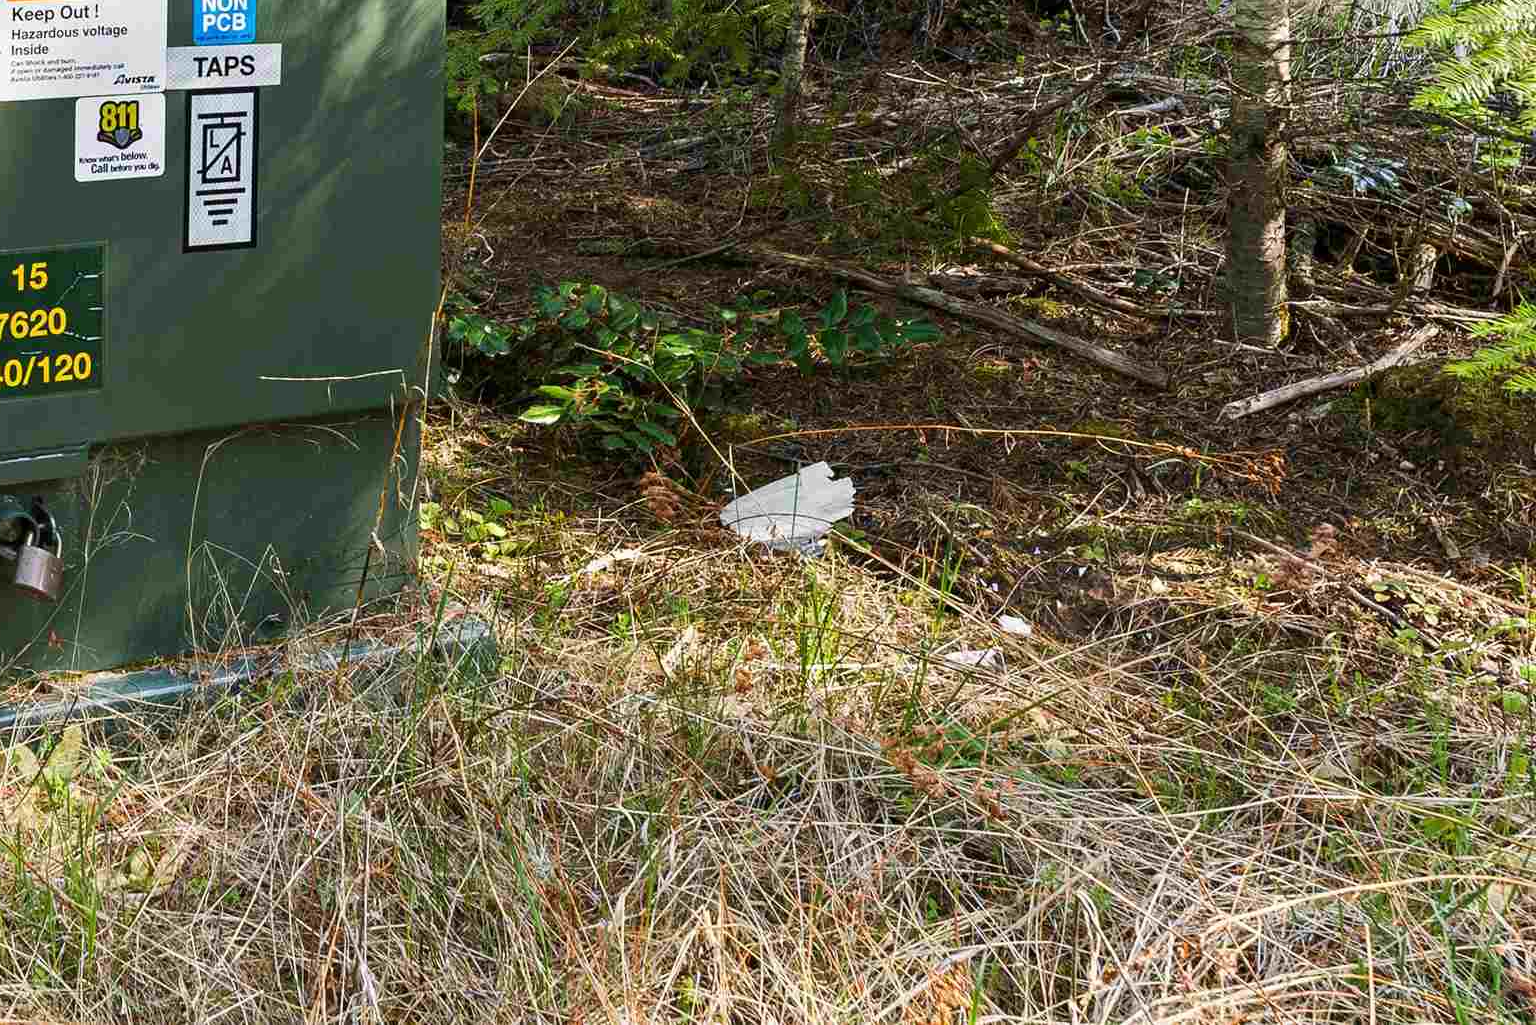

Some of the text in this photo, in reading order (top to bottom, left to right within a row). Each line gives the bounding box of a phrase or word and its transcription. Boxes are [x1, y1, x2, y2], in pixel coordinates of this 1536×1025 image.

[12, 7, 55, 23] Keep
[60, 5, 89, 20] Out
[202, 12, 247, 32] PCB
[11, 25, 128, 40] Hazardous voltage
[11, 44, 49, 56] Inside
[193, 55, 255, 77] TAPS
[99, 101, 139, 132] 811
[210, 130, 220, 147] L
[91, 163, 109, 173] Call
[221, 156, 233, 174] A
[11, 262, 49, 291] 15
